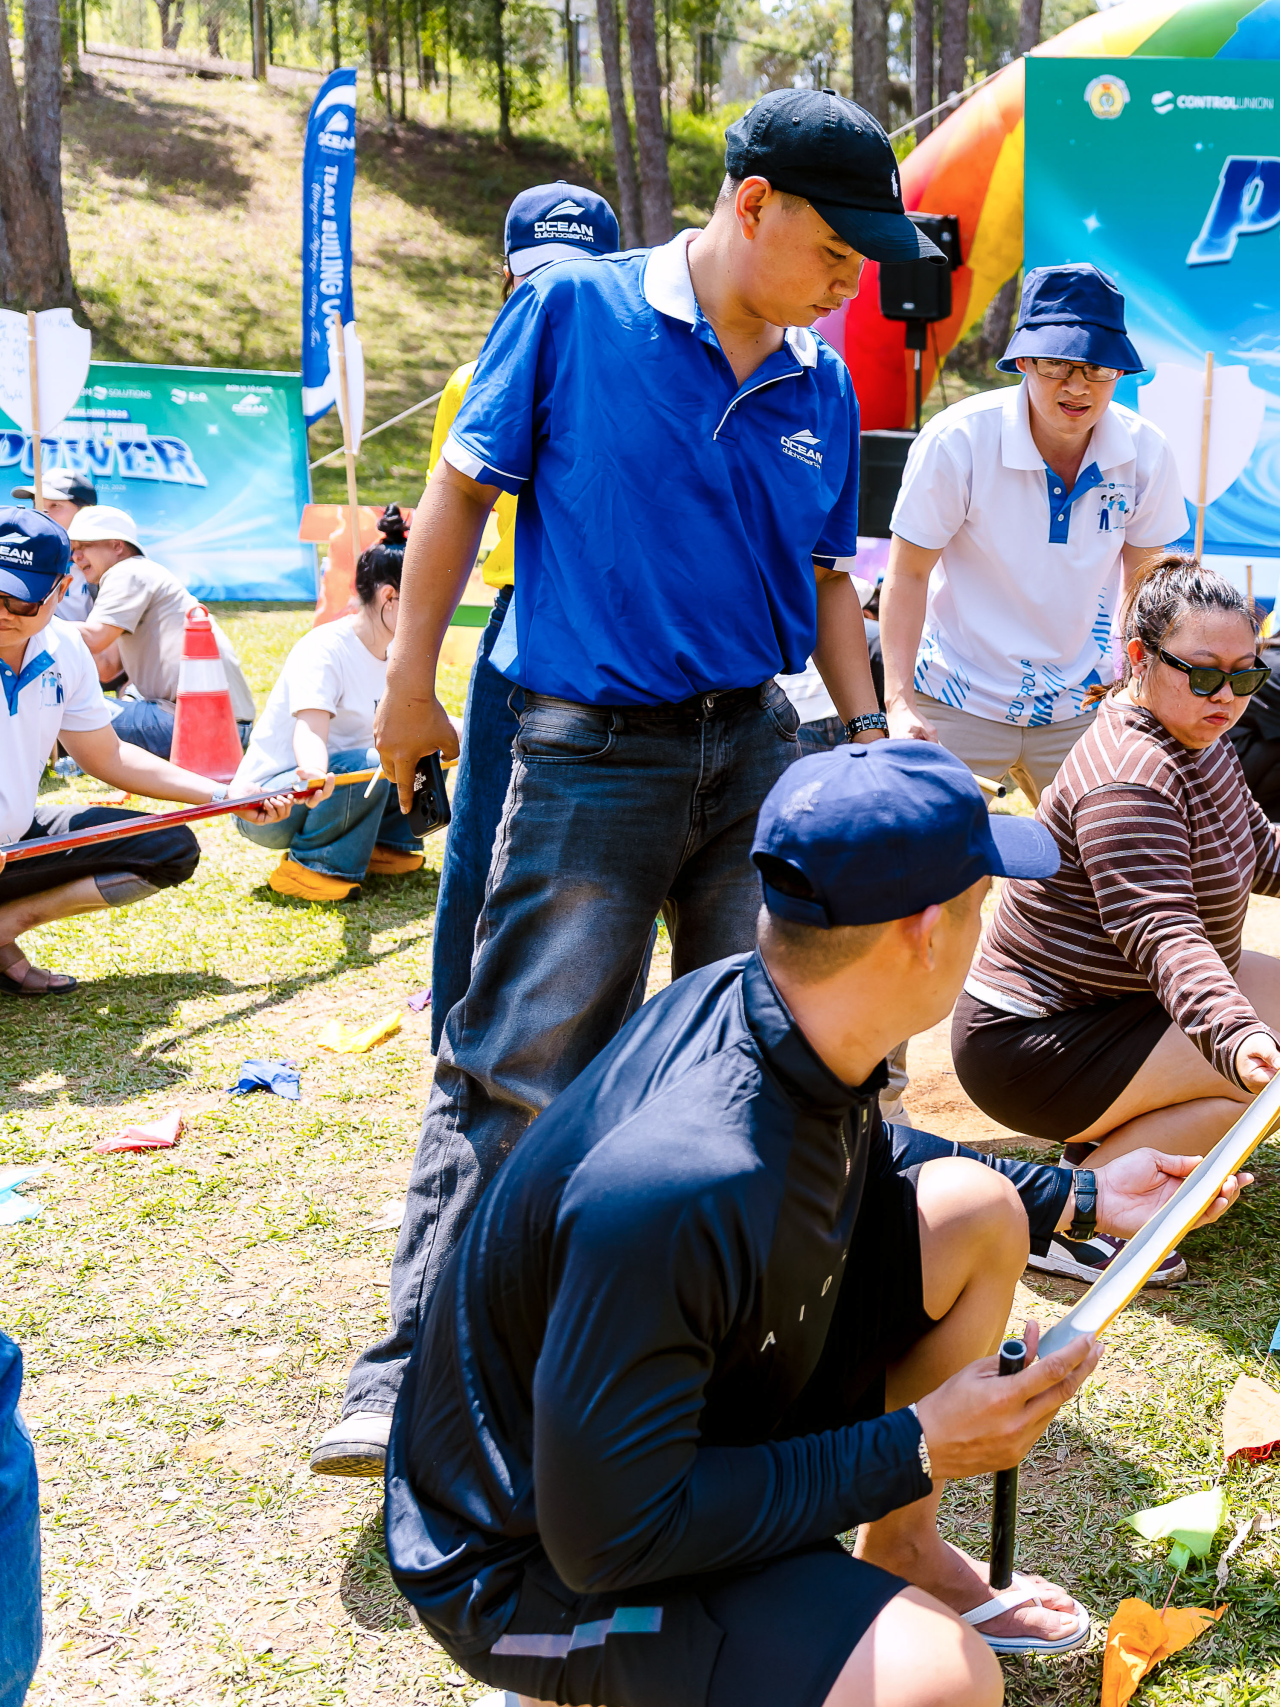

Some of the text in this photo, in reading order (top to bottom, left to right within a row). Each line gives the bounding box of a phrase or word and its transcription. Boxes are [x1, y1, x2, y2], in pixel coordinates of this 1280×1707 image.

[323, 165, 339, 216] TEAM
[534, 221, 594, 236] OCEAN
[534, 231, 594, 243] dulichocean.vn
[108, 388, 151, 399] SOLUTIONS
[780, 436, 823, 463] OCEAN
[0, 545, 33, 561] EAN
[1005, 700, 1025, 723] PCU
